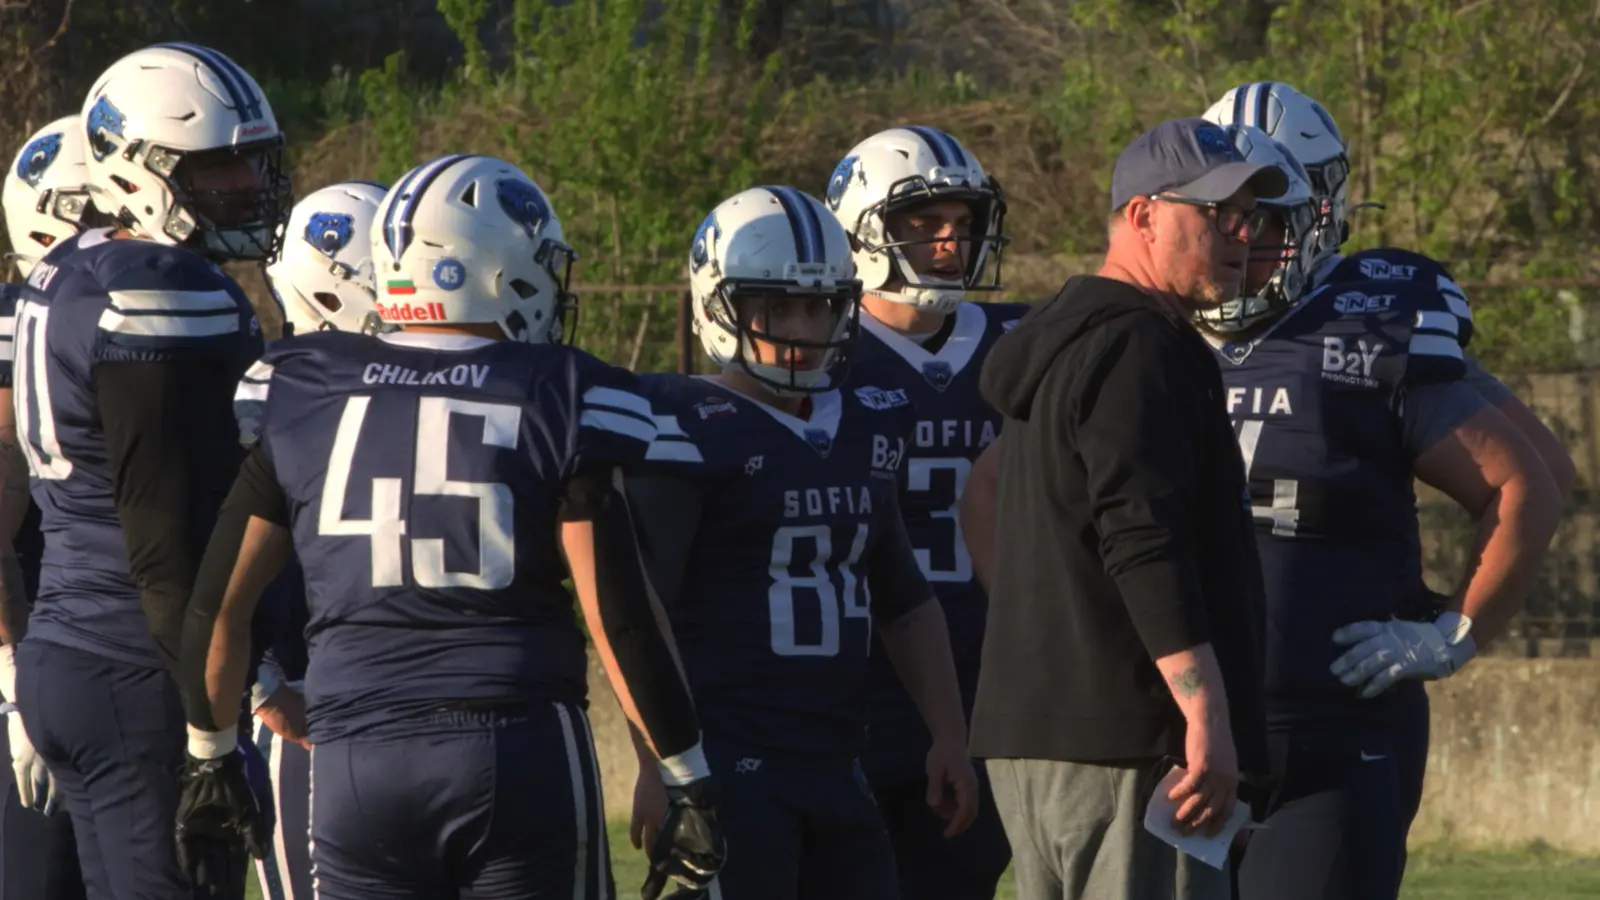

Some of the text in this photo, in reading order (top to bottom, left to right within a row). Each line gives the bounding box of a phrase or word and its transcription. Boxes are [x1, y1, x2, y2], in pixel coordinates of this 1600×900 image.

[440, 266, 459, 283] 45
[376, 302, 447, 321] Riddell
[1323, 336, 1384, 377] B2Y
[362, 363, 490, 388] CHILIKOV
[1227, 387, 1293, 415] FIA
[916, 419, 996, 448] OFIA
[318, 396, 522, 590] 45
[1231, 420, 1300, 537] 4
[783, 486, 873, 518] SOFIA
[768, 523, 872, 658] 84
